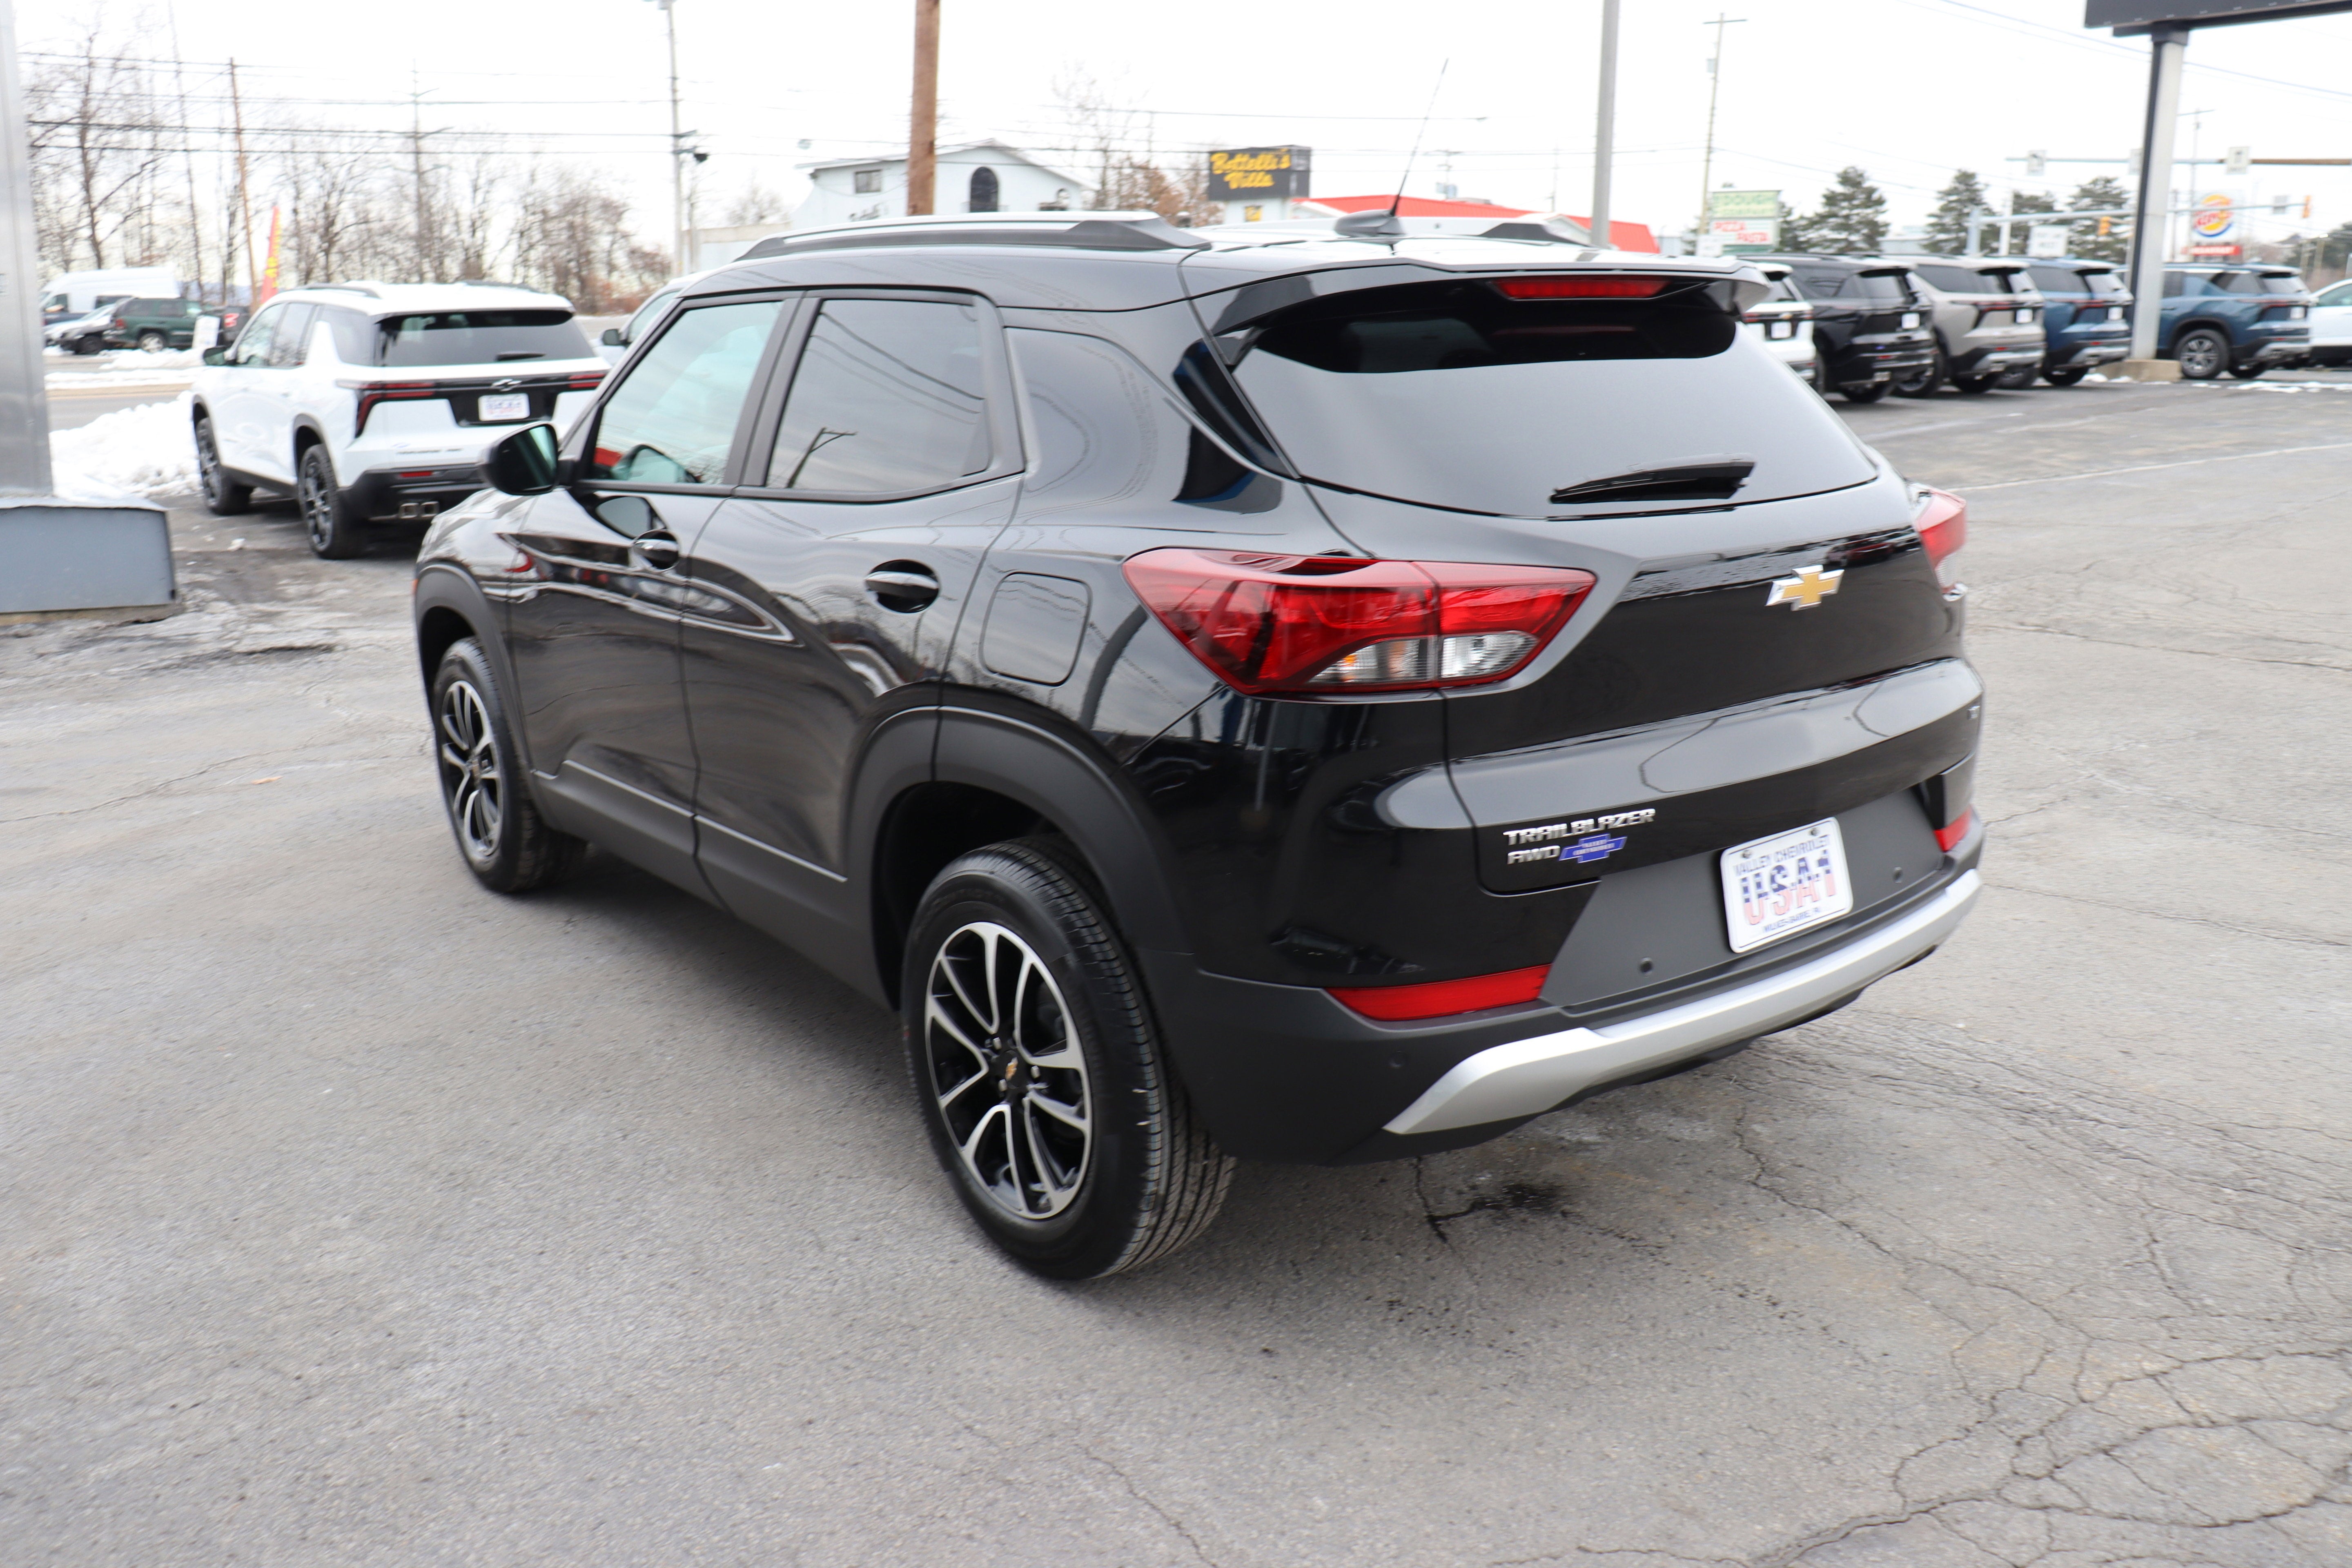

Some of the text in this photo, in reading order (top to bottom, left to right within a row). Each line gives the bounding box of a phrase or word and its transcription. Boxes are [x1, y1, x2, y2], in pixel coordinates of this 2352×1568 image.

[1503, 808, 1656, 846] TRAILBLAZER
[1507, 845, 1561, 865] AWD
[1734, 853, 1771, 875] VALLEY
[1740, 849, 1836, 925] USA1
